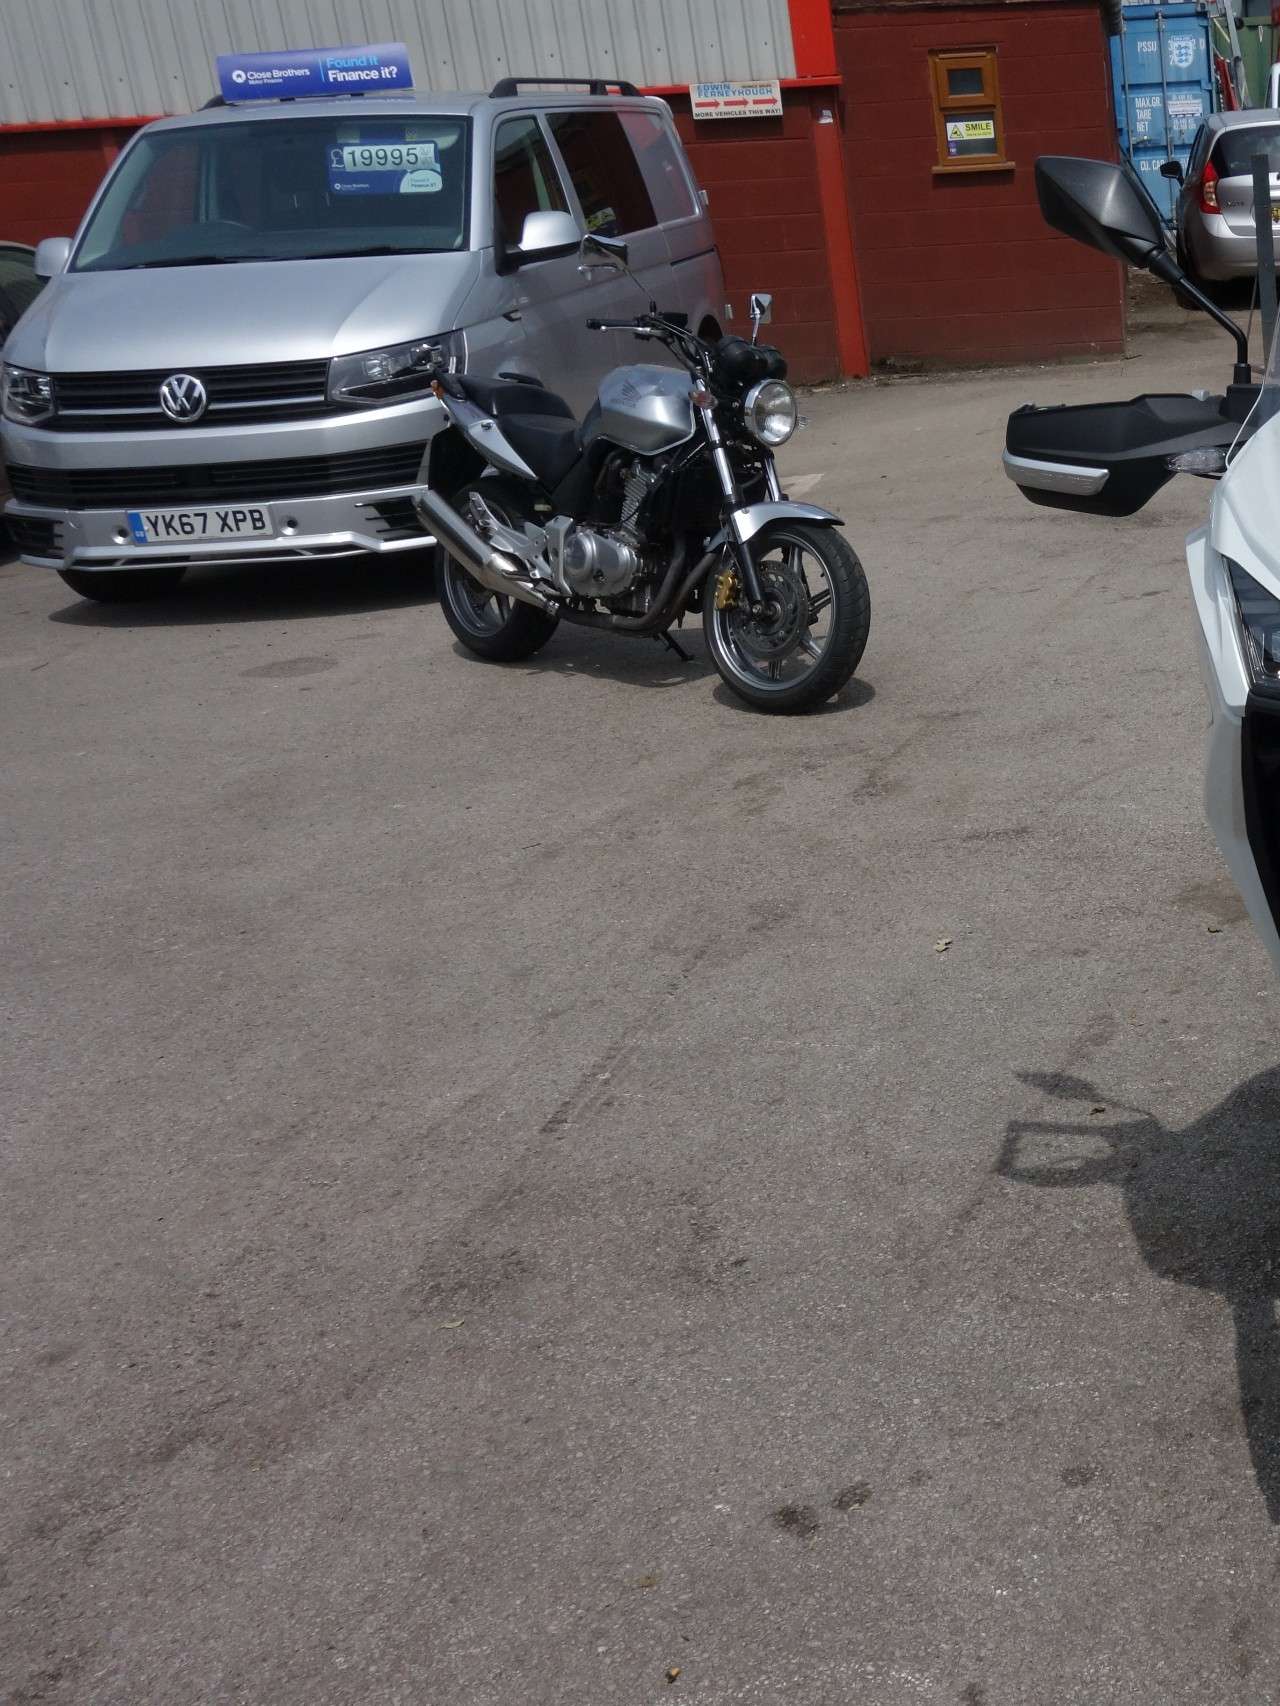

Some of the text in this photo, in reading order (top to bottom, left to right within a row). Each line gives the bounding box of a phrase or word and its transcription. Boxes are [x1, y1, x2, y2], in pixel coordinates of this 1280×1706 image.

[326, 55, 365, 69] Found
[247, 68, 310, 80] Close Brothers
[328, 66, 398, 83] Finance it?
[965, 122, 992, 131] SMILE
[146, 509, 266, 537] YK67 XPB
